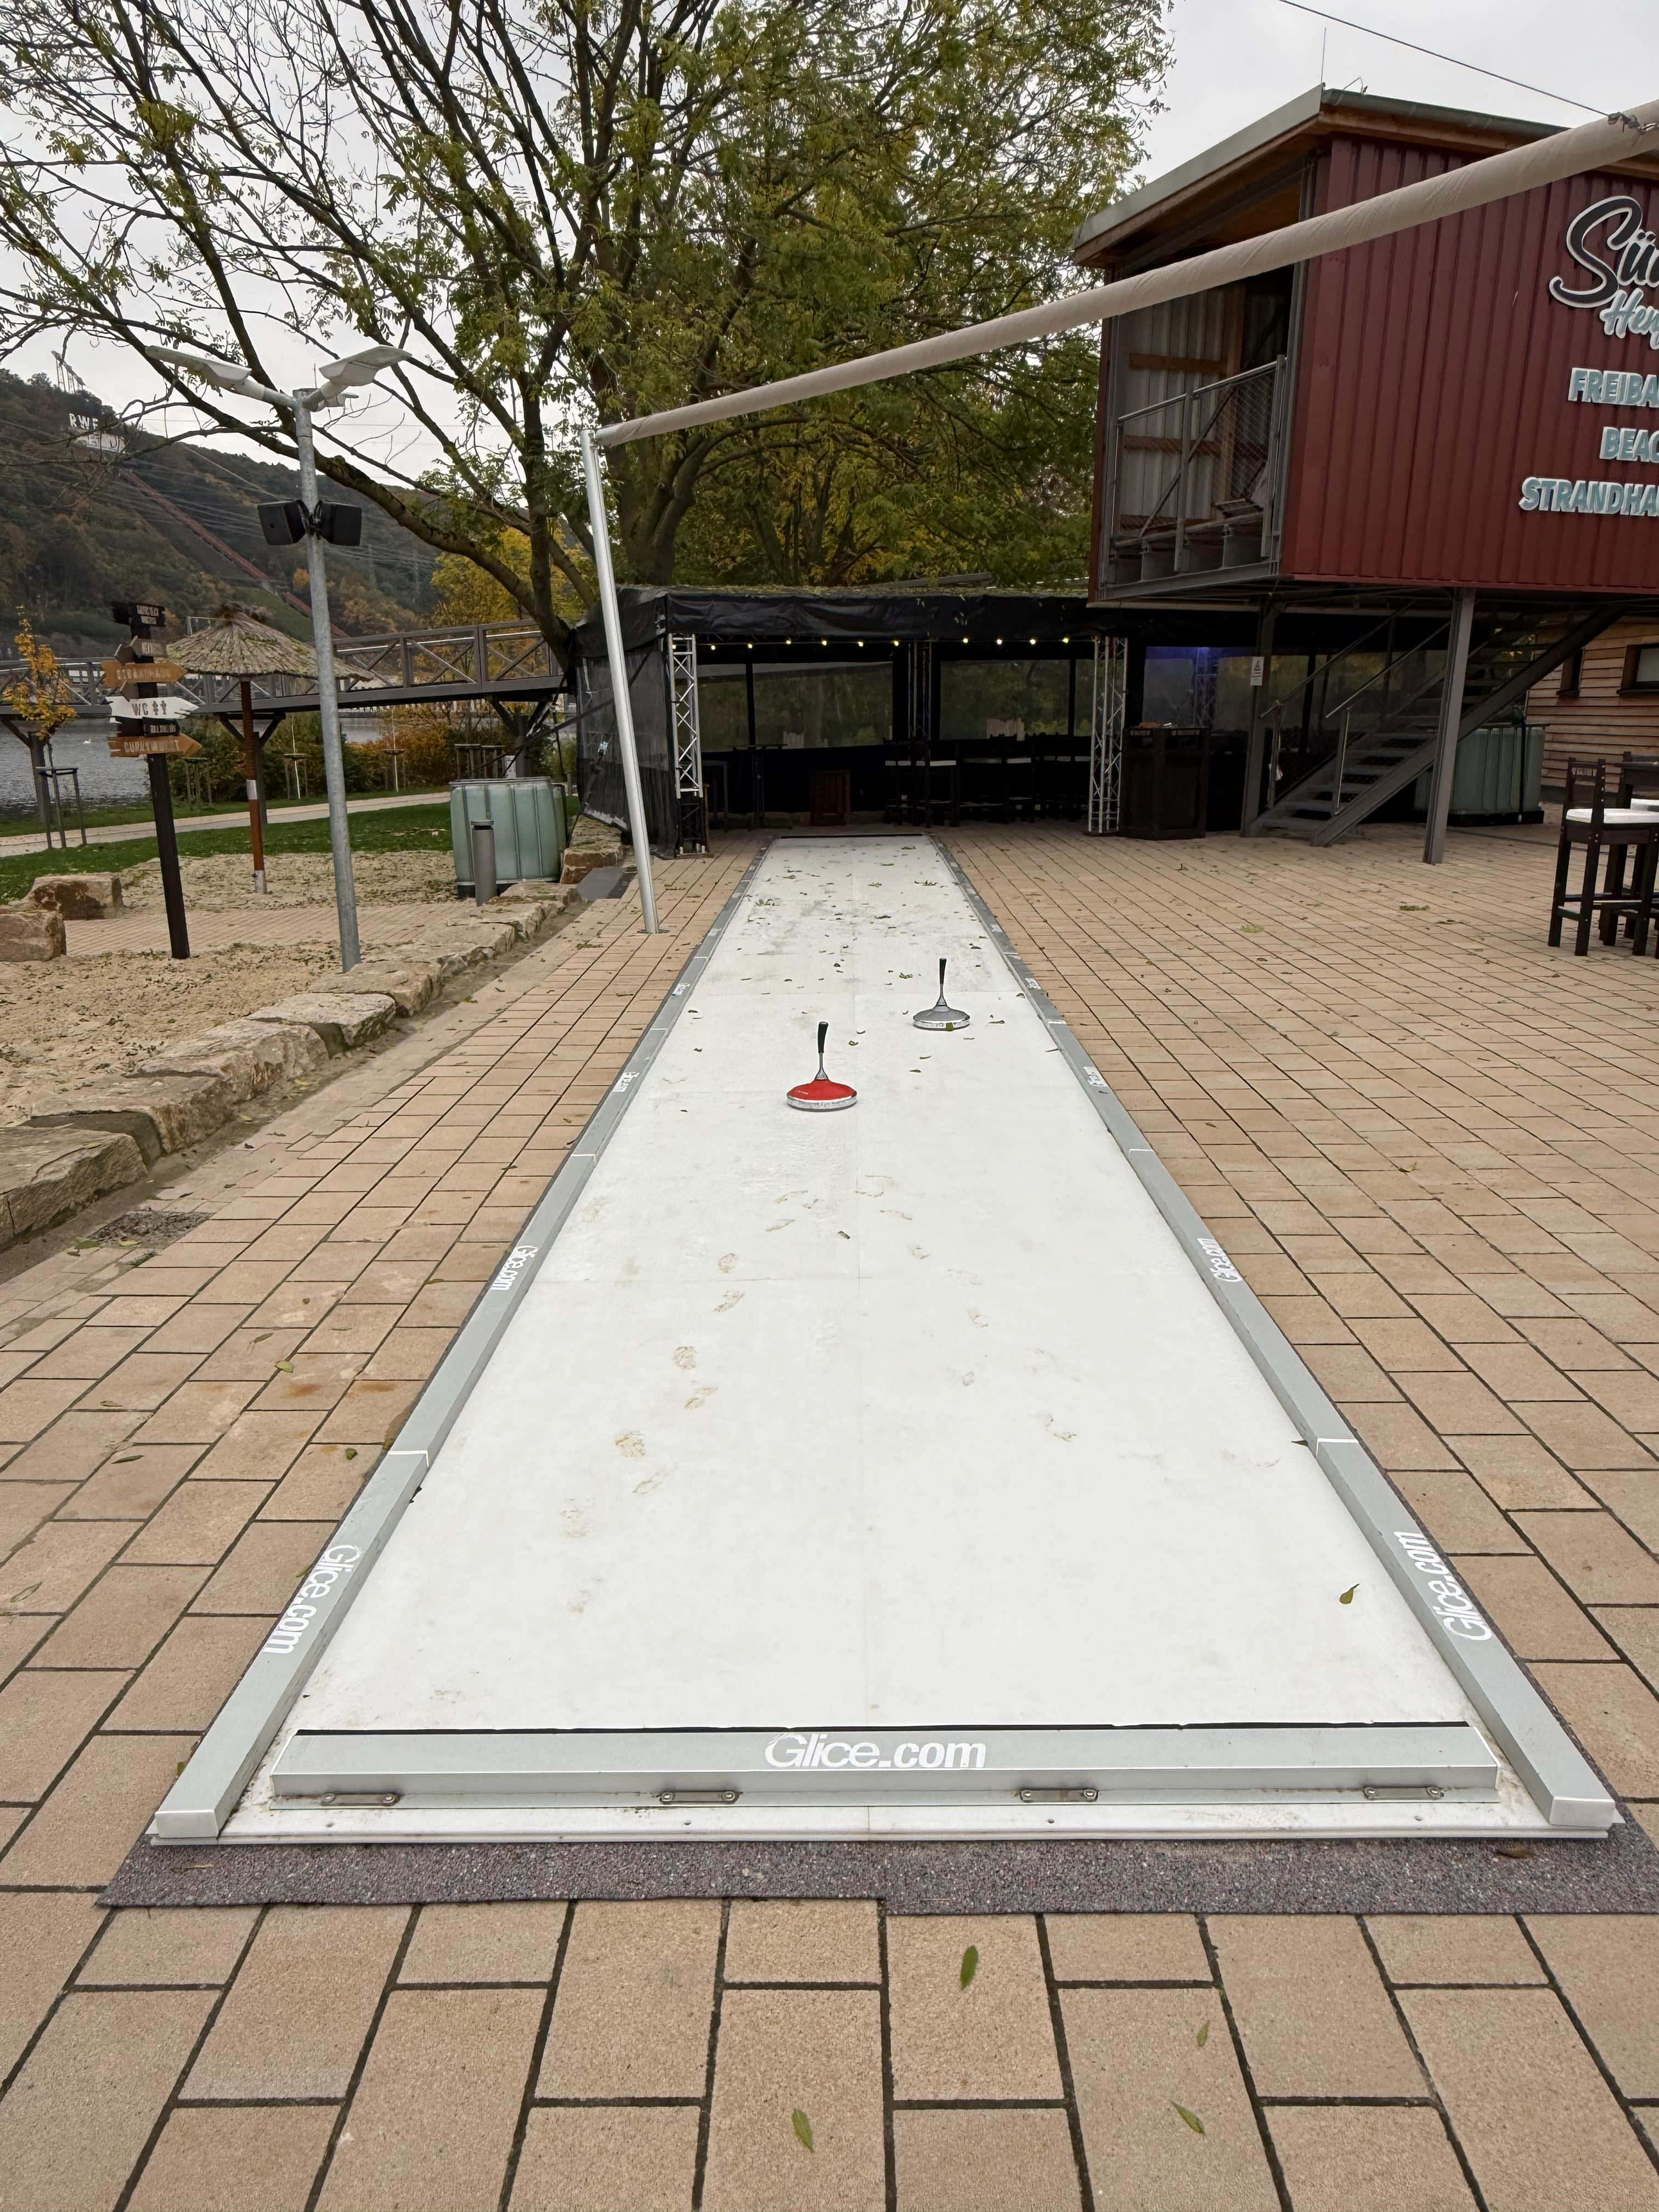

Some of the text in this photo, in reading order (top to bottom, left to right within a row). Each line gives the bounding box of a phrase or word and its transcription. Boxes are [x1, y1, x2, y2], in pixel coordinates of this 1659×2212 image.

[1568, 367, 1659, 408] FREIBA
[1519, 476, 1659, 517] STRANDHA
[132, 703, 148, 715] WC
[490, 1245, 539, 1290] Glice.com
[262, 1544, 361, 1654] Glice.com
[1394, 1531, 1492, 1640] Glice.com
[765, 1733, 986, 1768] Glice.com
